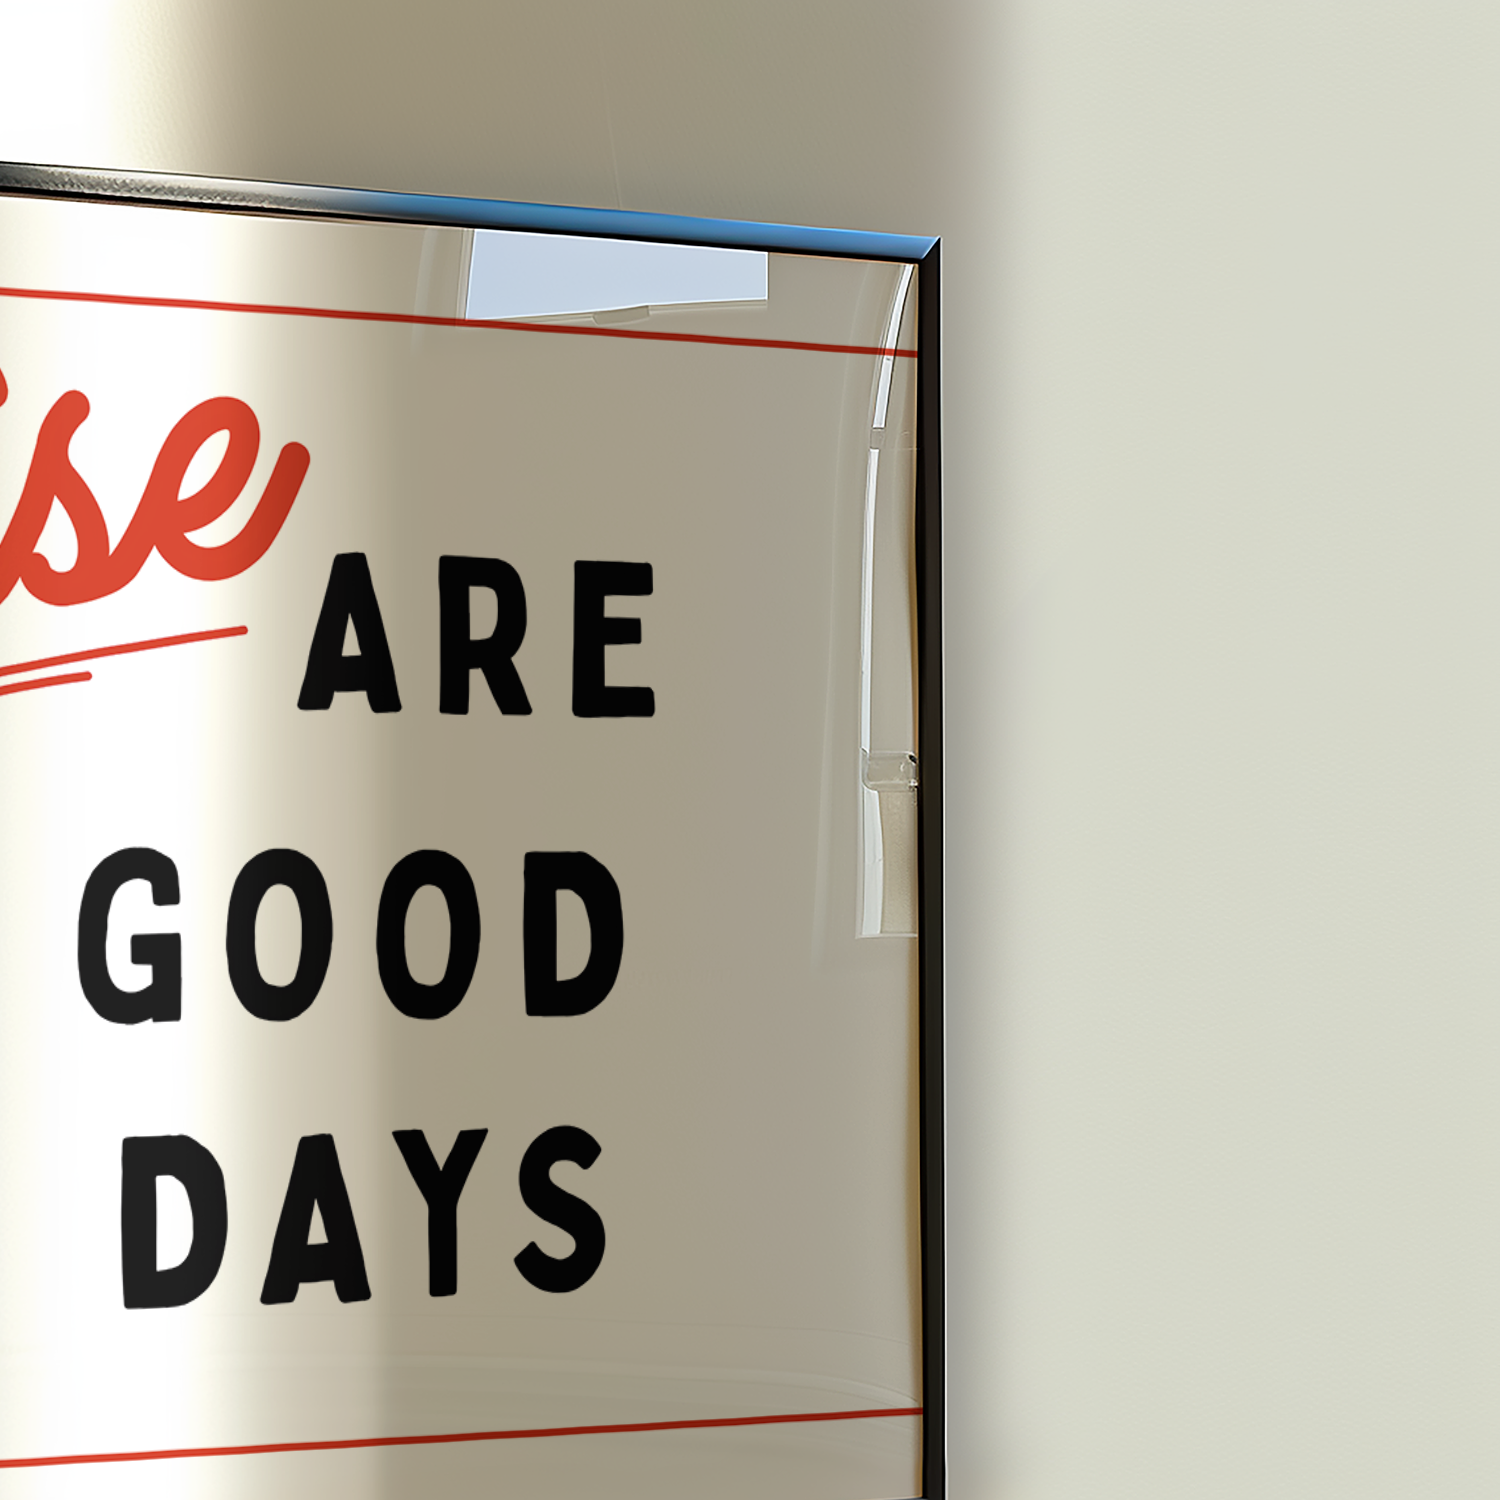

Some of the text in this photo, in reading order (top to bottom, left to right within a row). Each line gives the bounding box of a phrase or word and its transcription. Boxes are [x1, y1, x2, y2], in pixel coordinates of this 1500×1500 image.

[297, 551, 656, 719] ARE
[77, 847, 624, 1025] GOOD
[121, 1125, 606, 1309] DAYS
